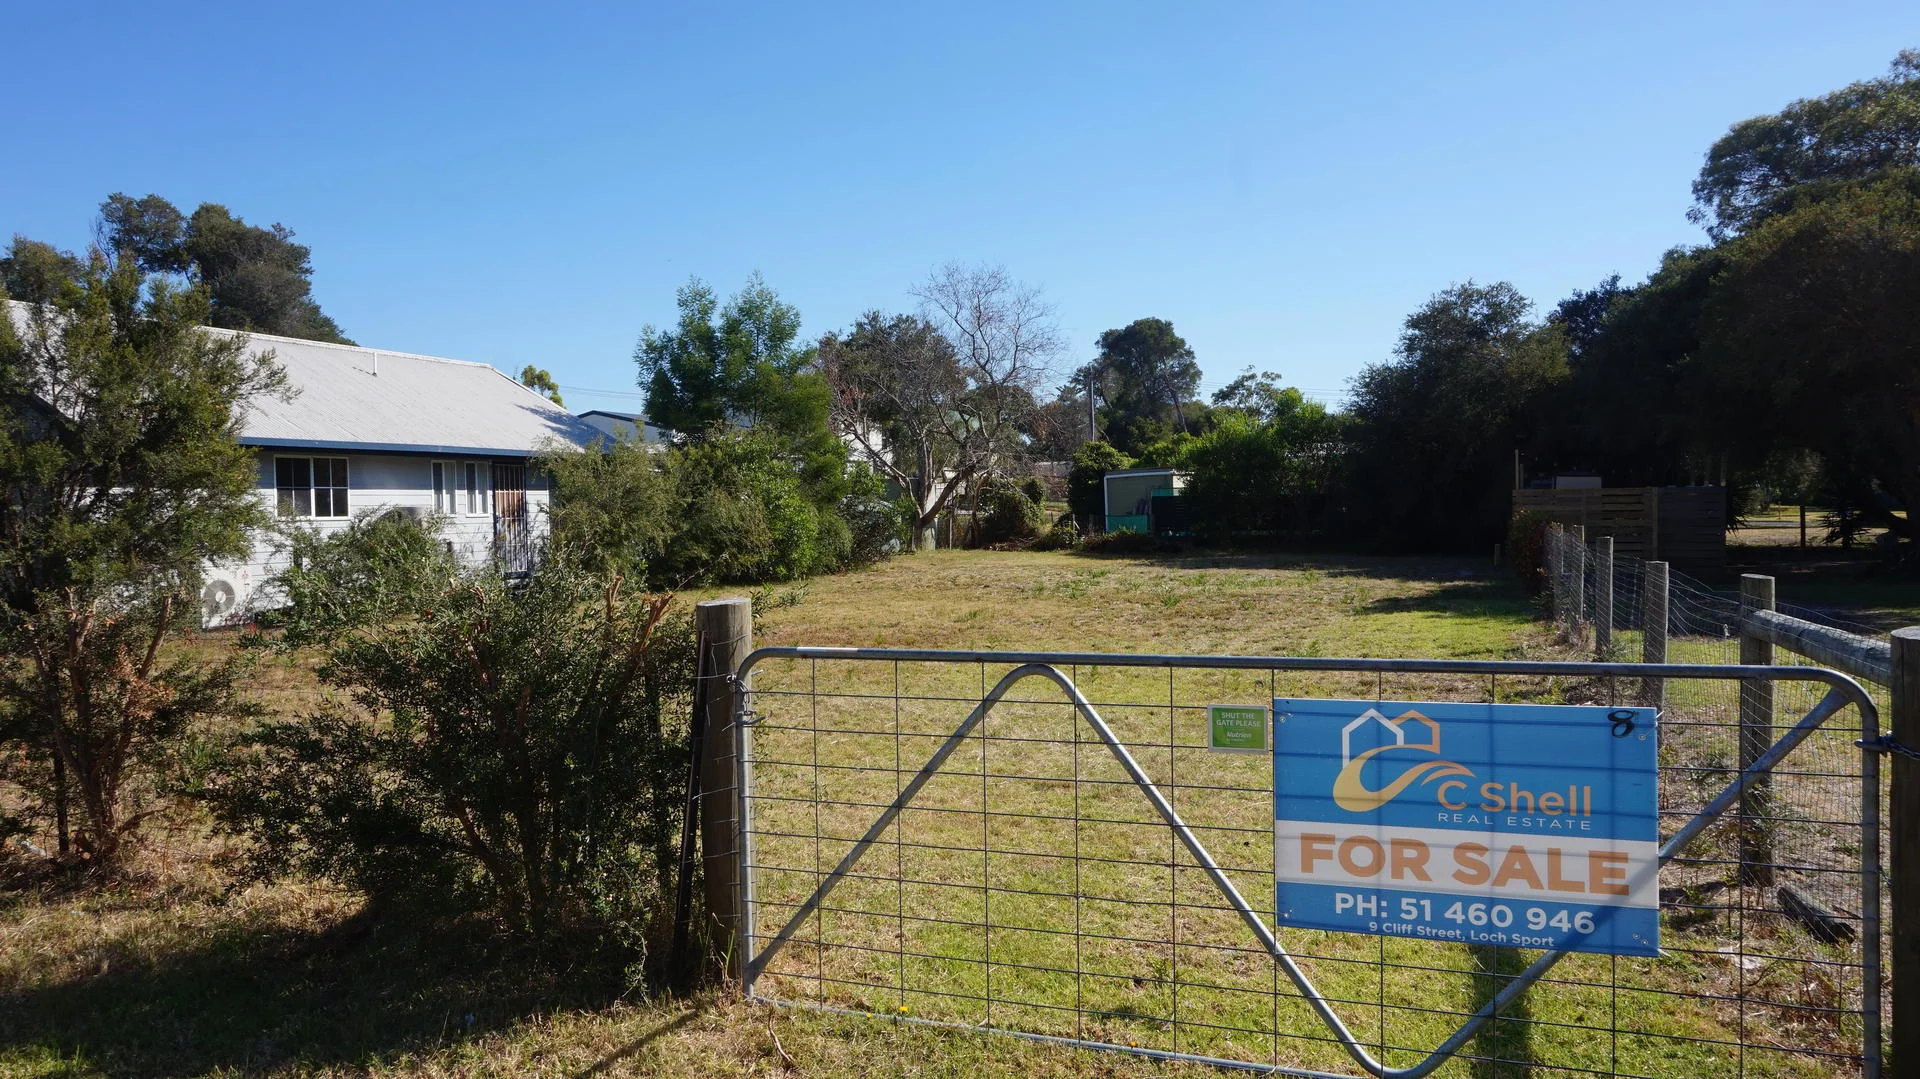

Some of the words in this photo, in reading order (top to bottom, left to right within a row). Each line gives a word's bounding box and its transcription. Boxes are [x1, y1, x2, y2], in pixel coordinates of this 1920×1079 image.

[1608, 709, 1635, 738] 8
[1437, 780, 1468, 811] C
[1480, 782, 1591, 817] Shell
[1438, 812, 1493, 825] REAL
[1507, 816, 1591, 830] ESTATE
[1300, 833, 1433, 882] FOR
[1451, 841, 1630, 896] SALE
[1335, 893, 1387, 919] PH:
[1400, 898, 1432, 921] 51
[1444, 901, 1513, 928] 460
[1526, 907, 1595, 934] 946
[1368, 921, 1378, 932] 9
[1382, 922, 1413, 935] Cliff
[1416, 926, 1466, 941] Street,
[1470, 930, 1506, 943] Loch
[1512, 933, 1554, 948] Sport
